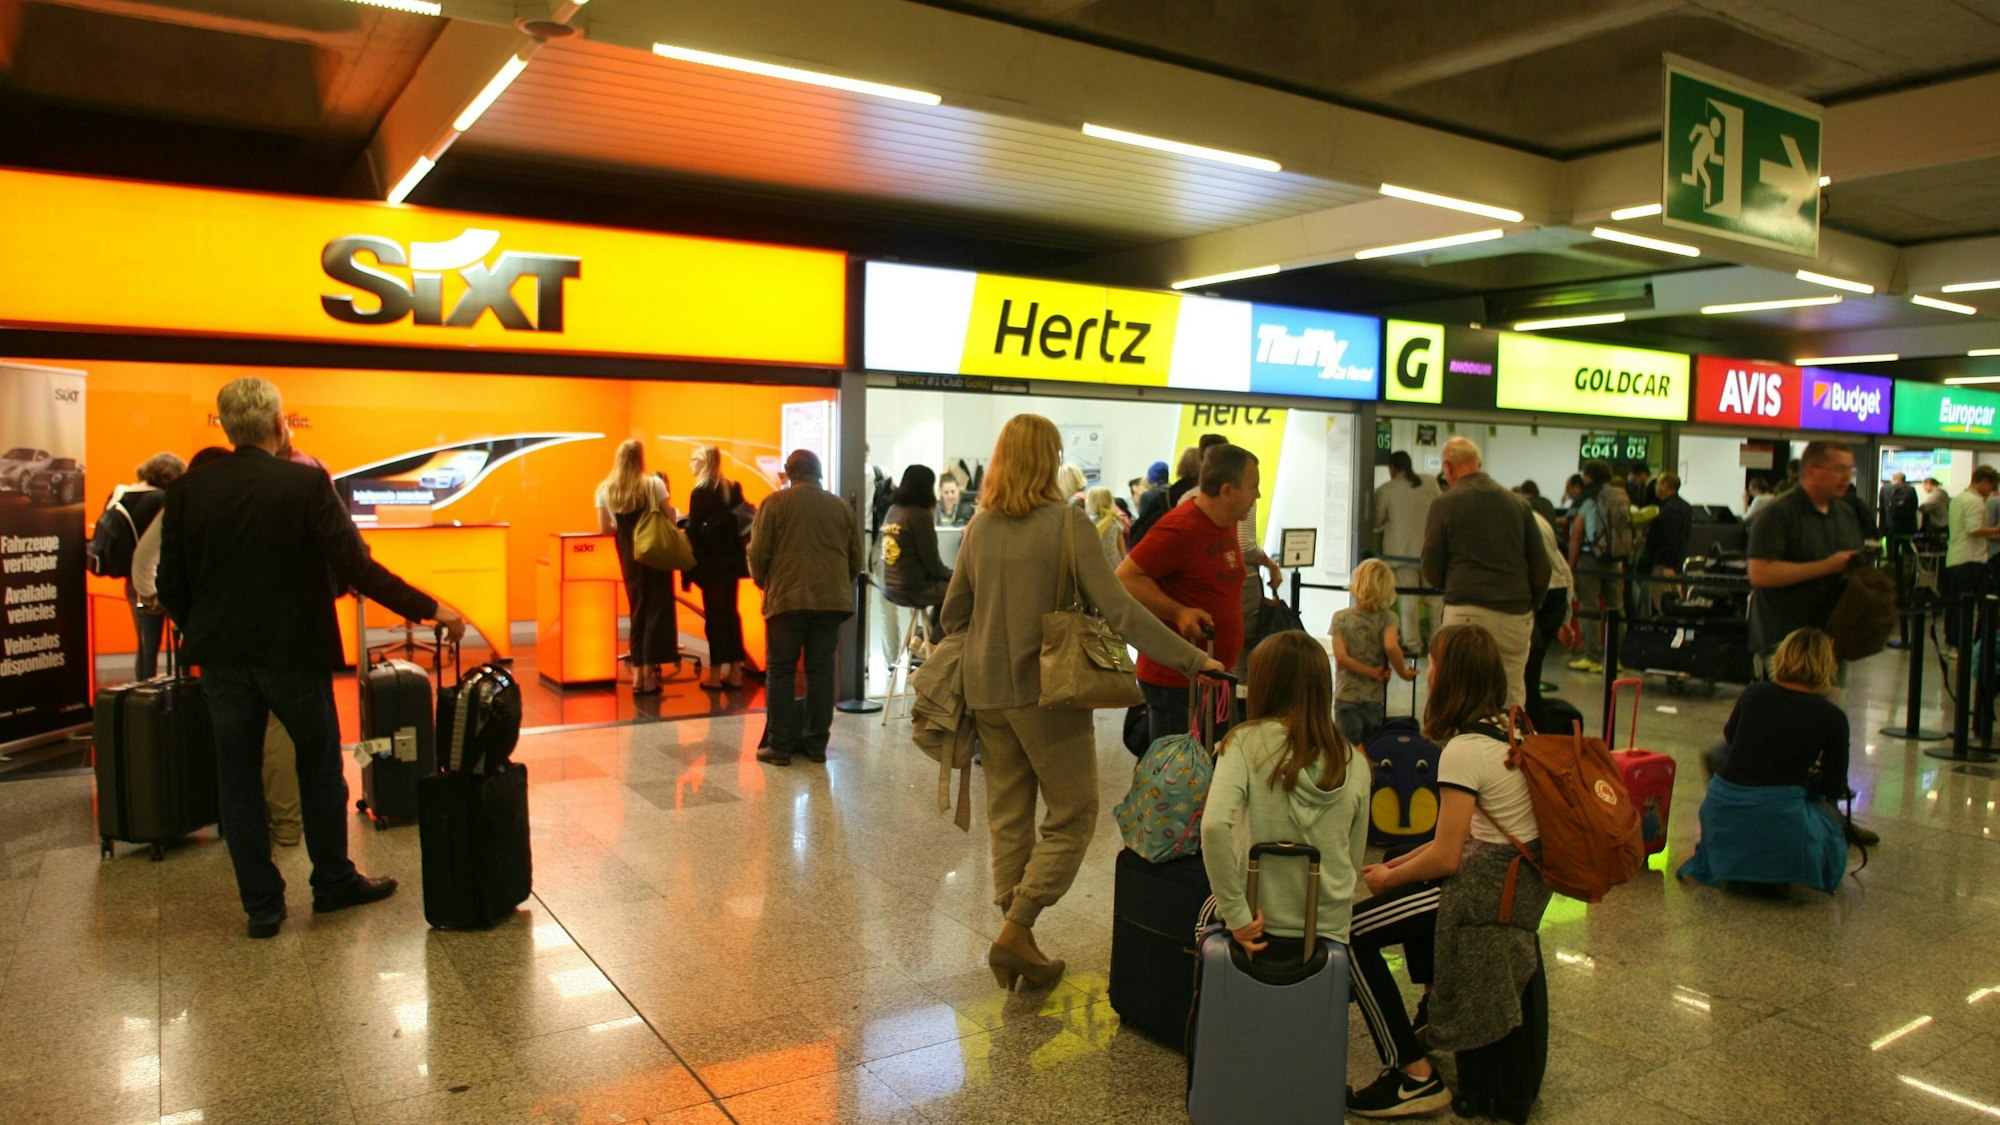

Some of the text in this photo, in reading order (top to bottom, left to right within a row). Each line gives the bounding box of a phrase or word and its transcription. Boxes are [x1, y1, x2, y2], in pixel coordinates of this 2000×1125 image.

[993, 299, 1152, 366] Hertz
[1397, 337, 1431, 389] G
[898, 374, 926, 386] Hertz
[942, 378, 963, 388] Club
[1575, 367, 1671, 397] GOLDCAR
[1719, 369, 1782, 417] AVIS
[1831, 382, 1881, 422] Budget
[1939, 396, 1996, 433] Europcar
[1377, 433, 1391, 450] 05
[1581, 443, 1646, 460] C041 05
[1, 535, 60, 554] Fahrzeuge
[3, 554, 58, 574] verfügbar
[5, 583, 57, 605] Available
[7, 603, 56, 624] vehicles
[0, 651, 65, 677] disponibles
